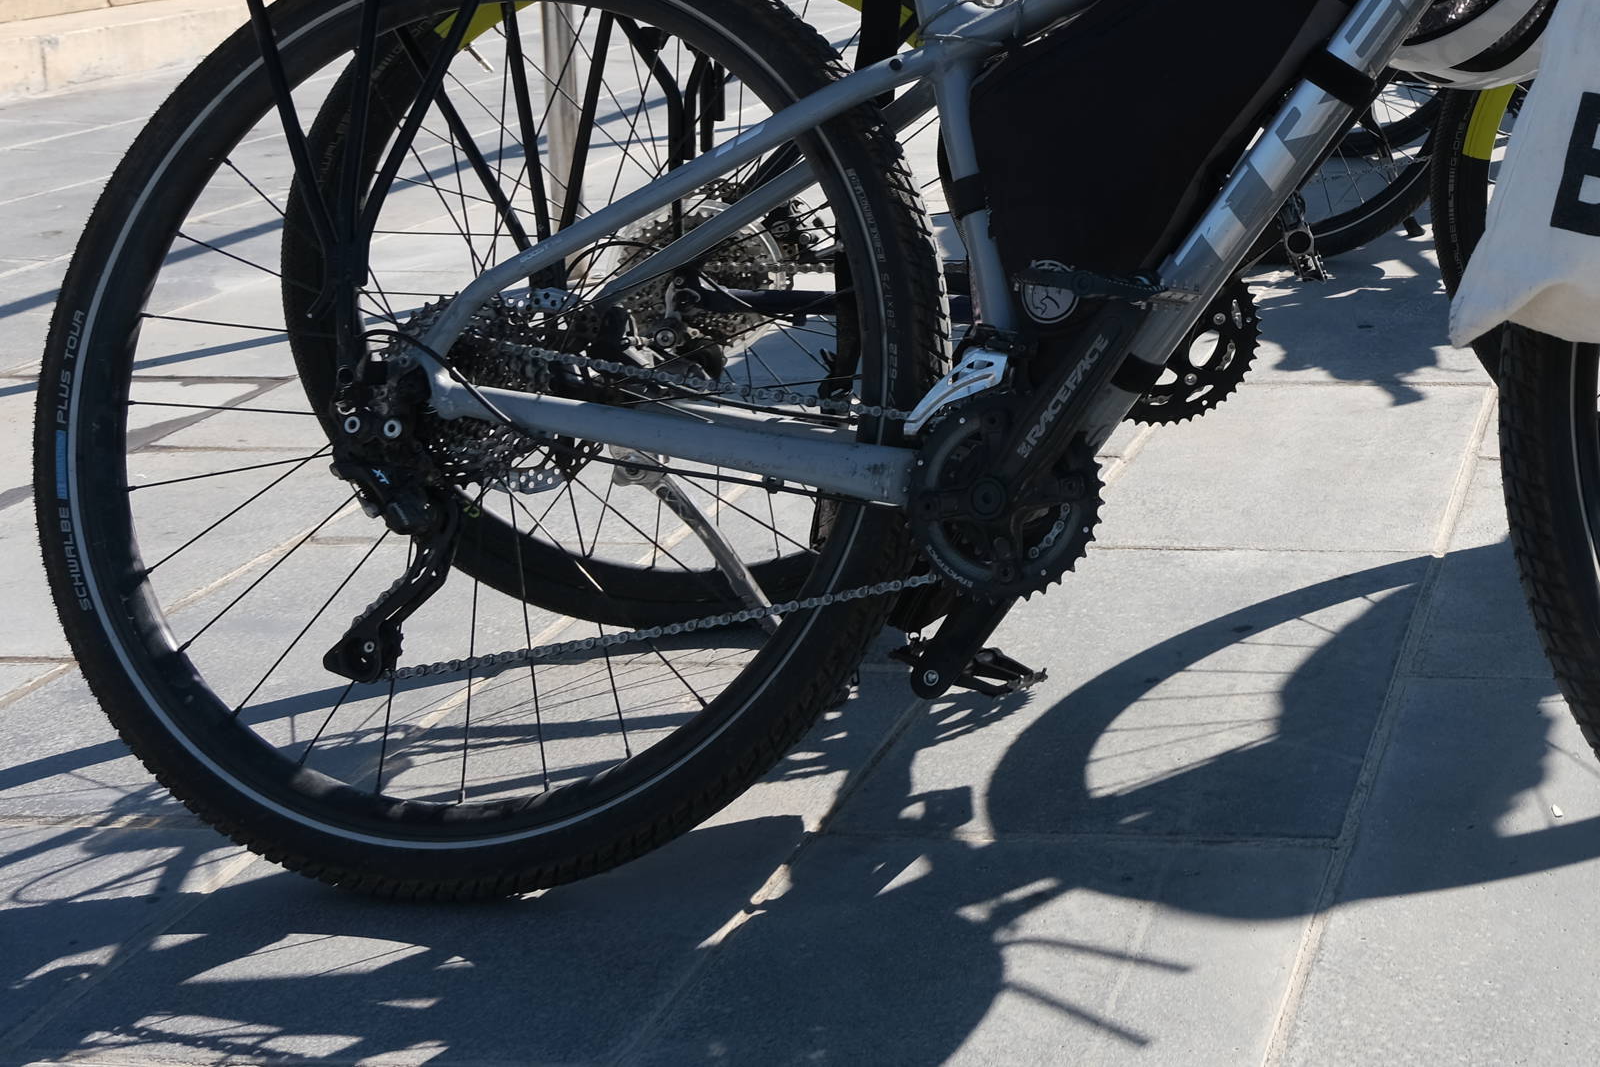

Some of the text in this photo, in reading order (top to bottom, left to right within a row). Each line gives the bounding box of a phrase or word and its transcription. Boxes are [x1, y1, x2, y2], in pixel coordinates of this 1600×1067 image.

[63, 309, 84, 360] TOUR
[55, 369, 72, 425] PLUS
[1025, 332, 1109, 450] RACEFACE
[57, 505, 93, 613] SCHWALBE
